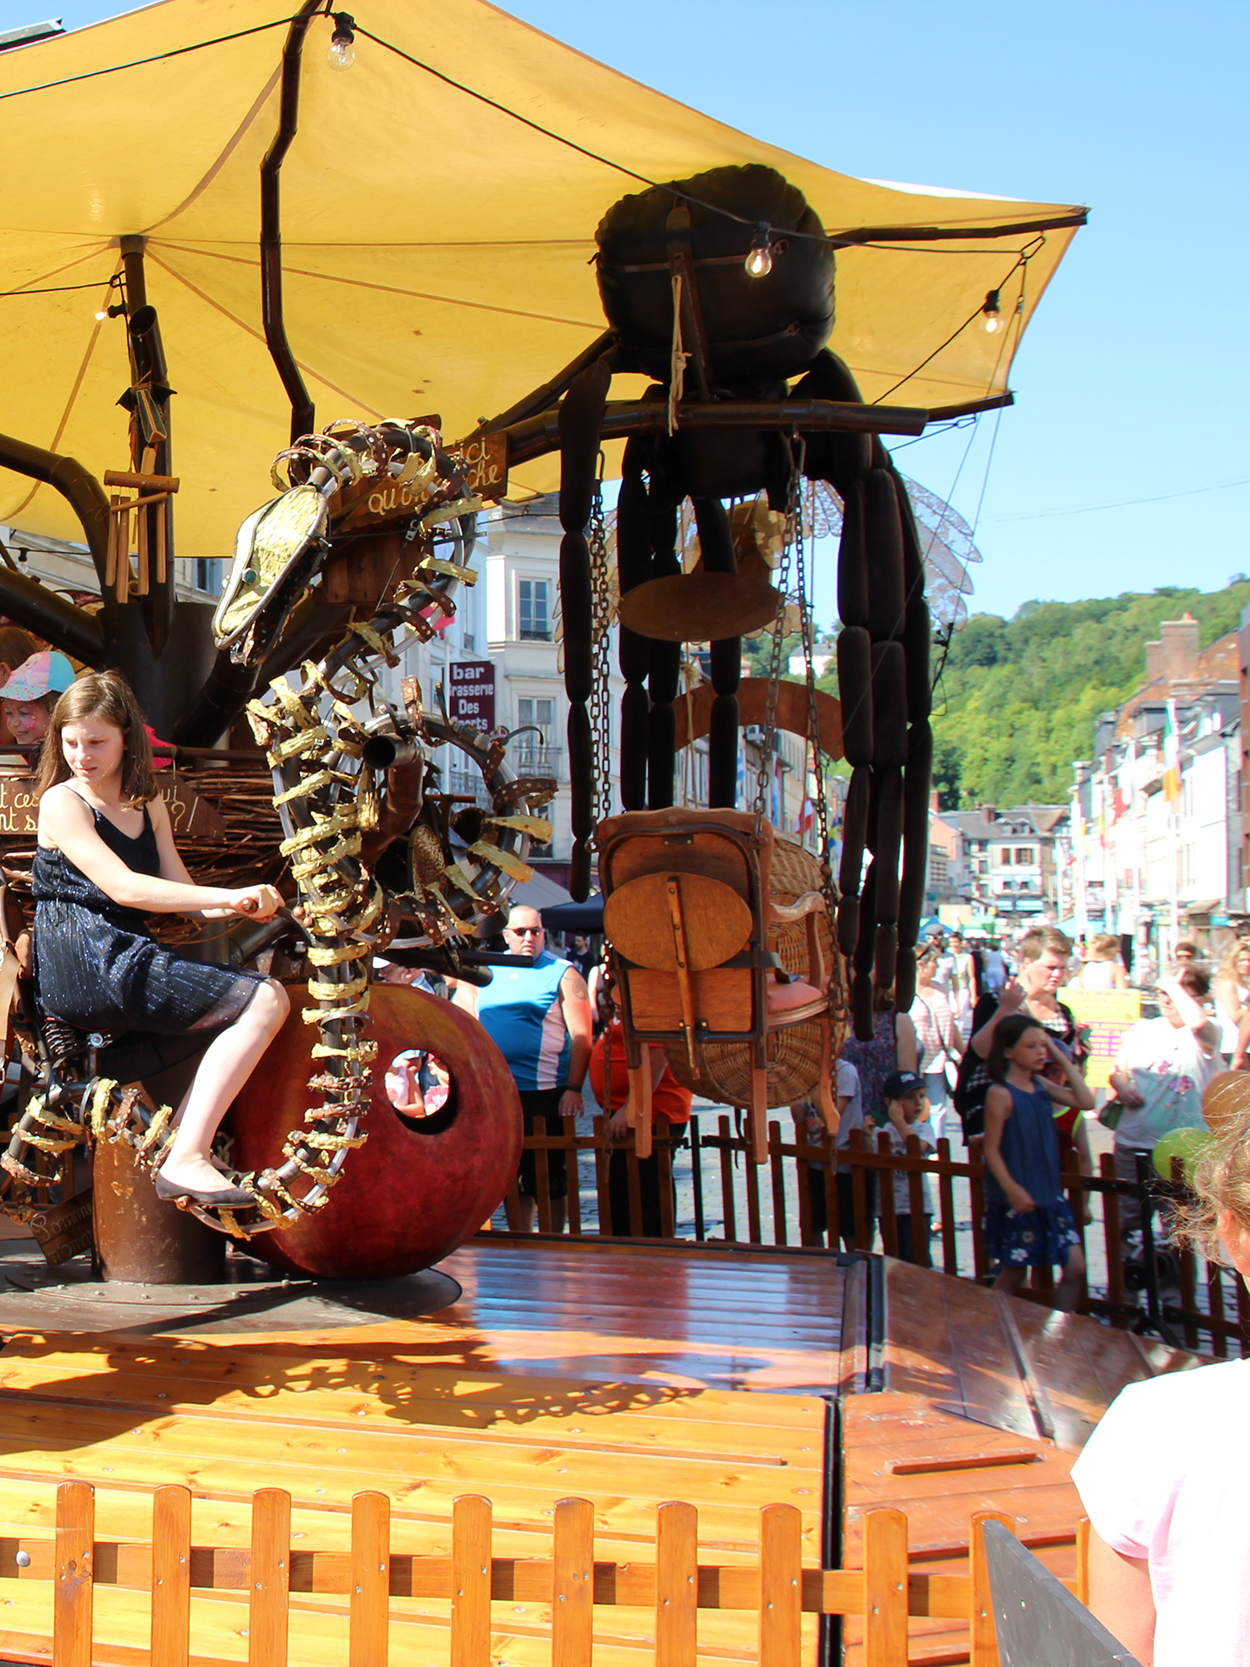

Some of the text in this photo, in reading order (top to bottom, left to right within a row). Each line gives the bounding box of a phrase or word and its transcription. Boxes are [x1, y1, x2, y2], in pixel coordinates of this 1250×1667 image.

[452, 664, 485, 680] bar
[450, 682, 495, 698] rasserie
[458, 698, 480, 715] Des
